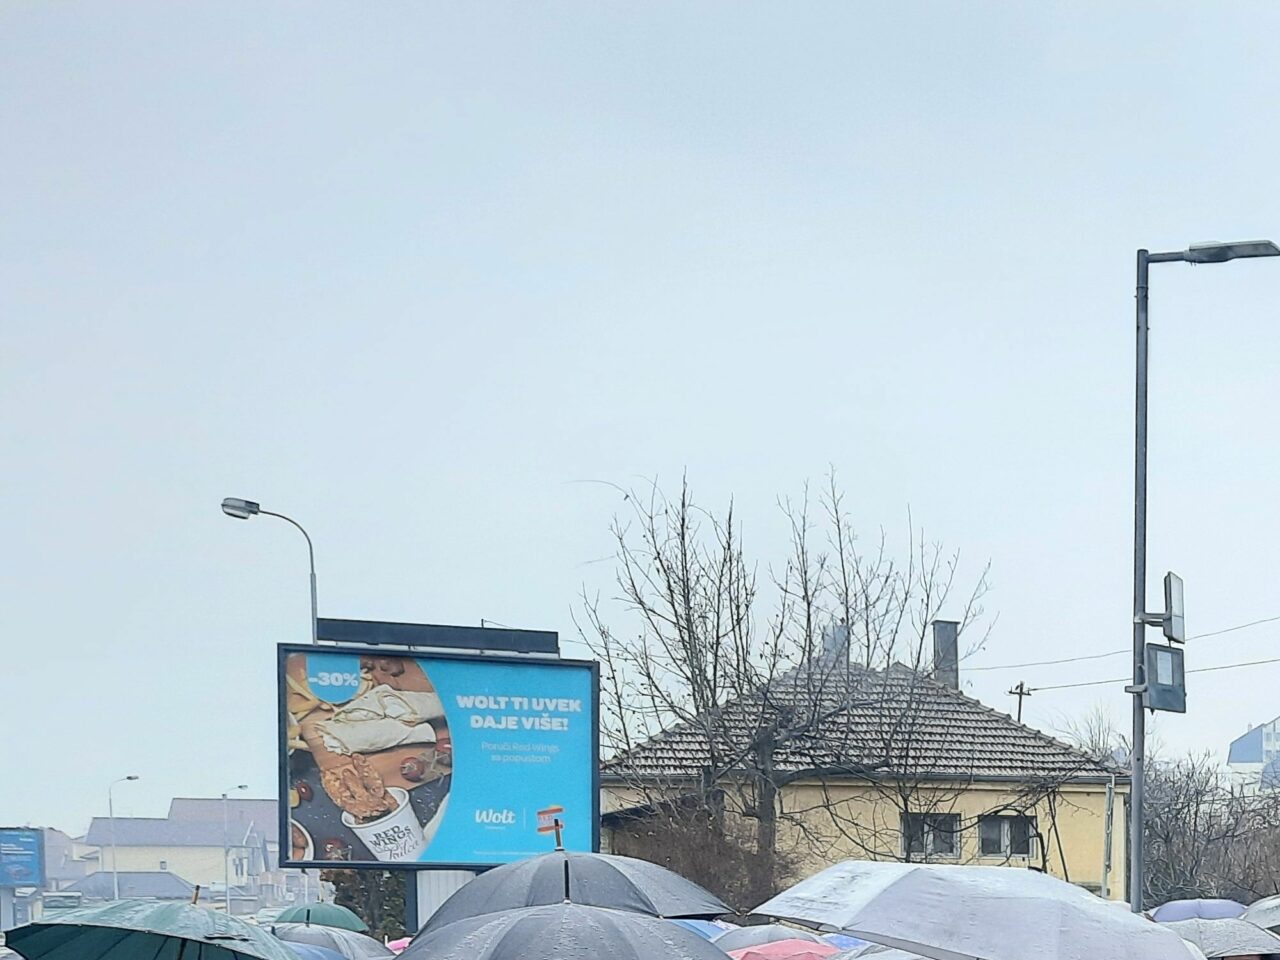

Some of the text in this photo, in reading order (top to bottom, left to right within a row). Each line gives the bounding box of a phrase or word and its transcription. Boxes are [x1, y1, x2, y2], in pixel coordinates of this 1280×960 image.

[309, 672, 359, 687] -30%
[456, 696, 580, 711] WOLT TI UVEK
[470, 713, 568, 731] DAJE VIŠE!
[475, 809, 516, 824] Wolt
[369, 826, 411, 846] WINGS
[373, 825, 401, 840] RED
